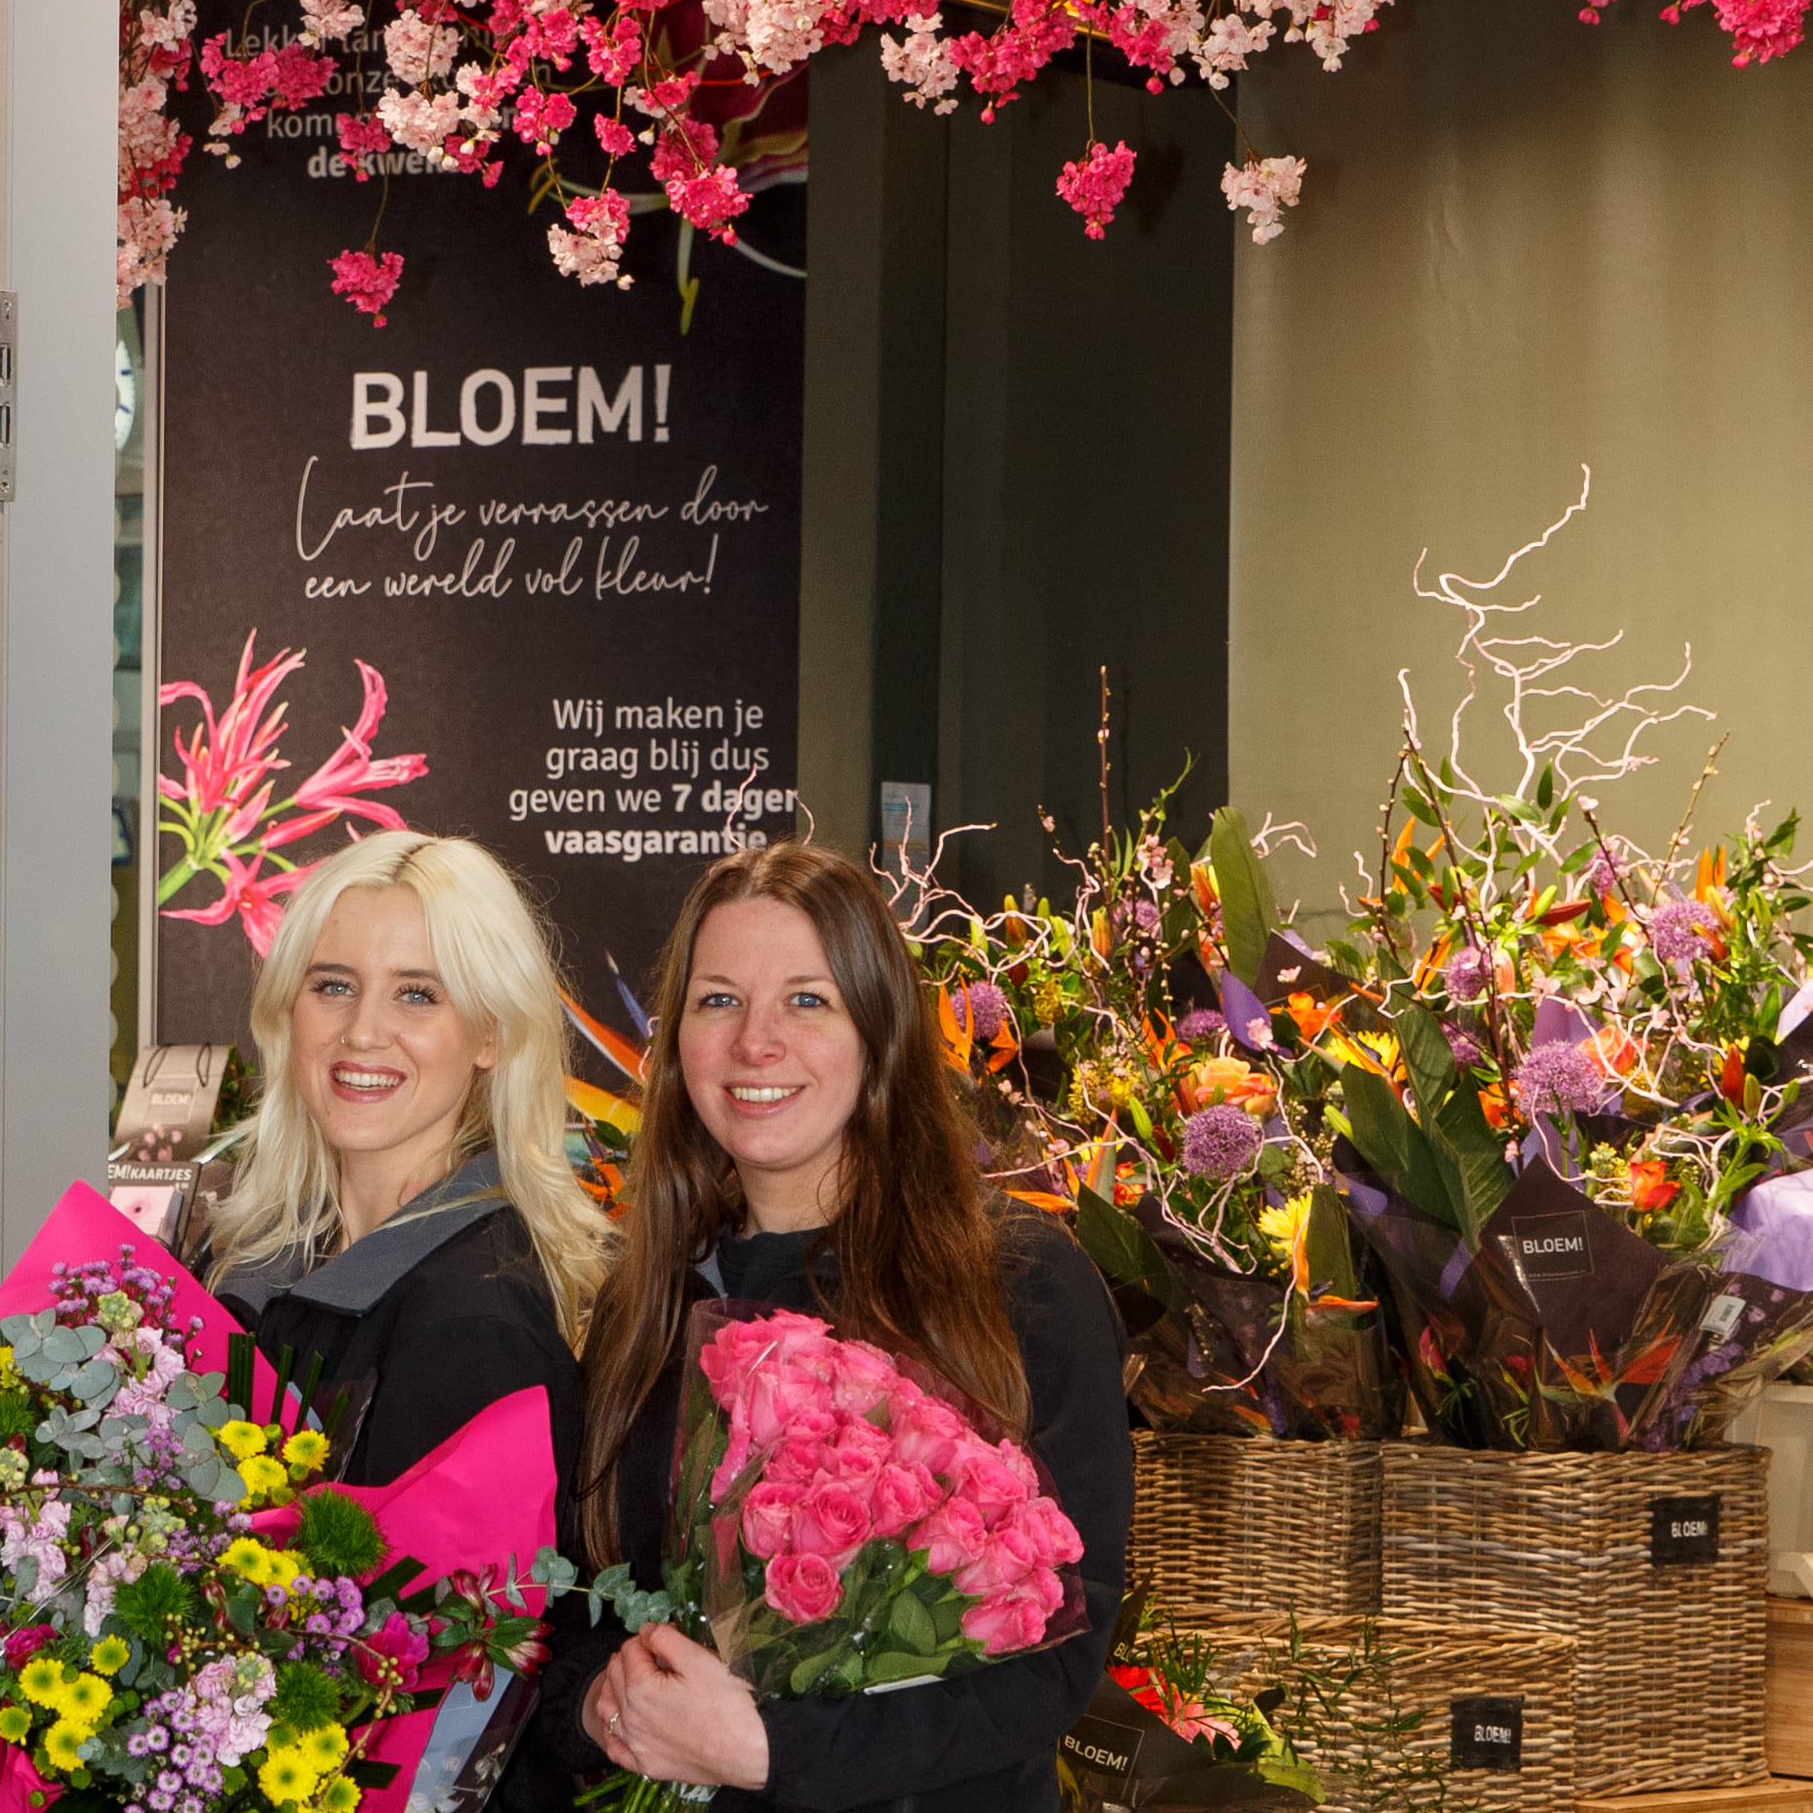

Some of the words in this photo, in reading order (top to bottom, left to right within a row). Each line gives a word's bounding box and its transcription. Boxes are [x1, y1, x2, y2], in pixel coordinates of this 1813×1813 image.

[307, 146, 347, 178] de
[350, 363, 673, 451] BLOEM!
[296, 455, 434, 562] Laat
[479, 498, 670, 529] verrassen
[680, 465, 770, 526] door
[304, 571, 372, 600] een
[384, 537, 517, 599] wereld
[524, 536, 584, 597] vol
[595, 533, 720, 601] kleur!
[552, 697, 604, 737] Wij
[614, 696, 724, 730] maken
[733, 698, 764, 737] je
[545, 746, 638, 779] graag
[649, 738, 700, 779] blij
[710, 738, 770, 772] dus
[508, 788, 606, 821] geven
[615, 789, 662, 813] we
[672, 784, 693, 813] 7
[544, 822, 768, 863] vaasgarantie
[1522, 1237, 1584, 1254] BLOEM!
[1064, 1735, 1129, 1771] BLOEM!
[1474, 1724, 1512, 1744] BLOEM!
